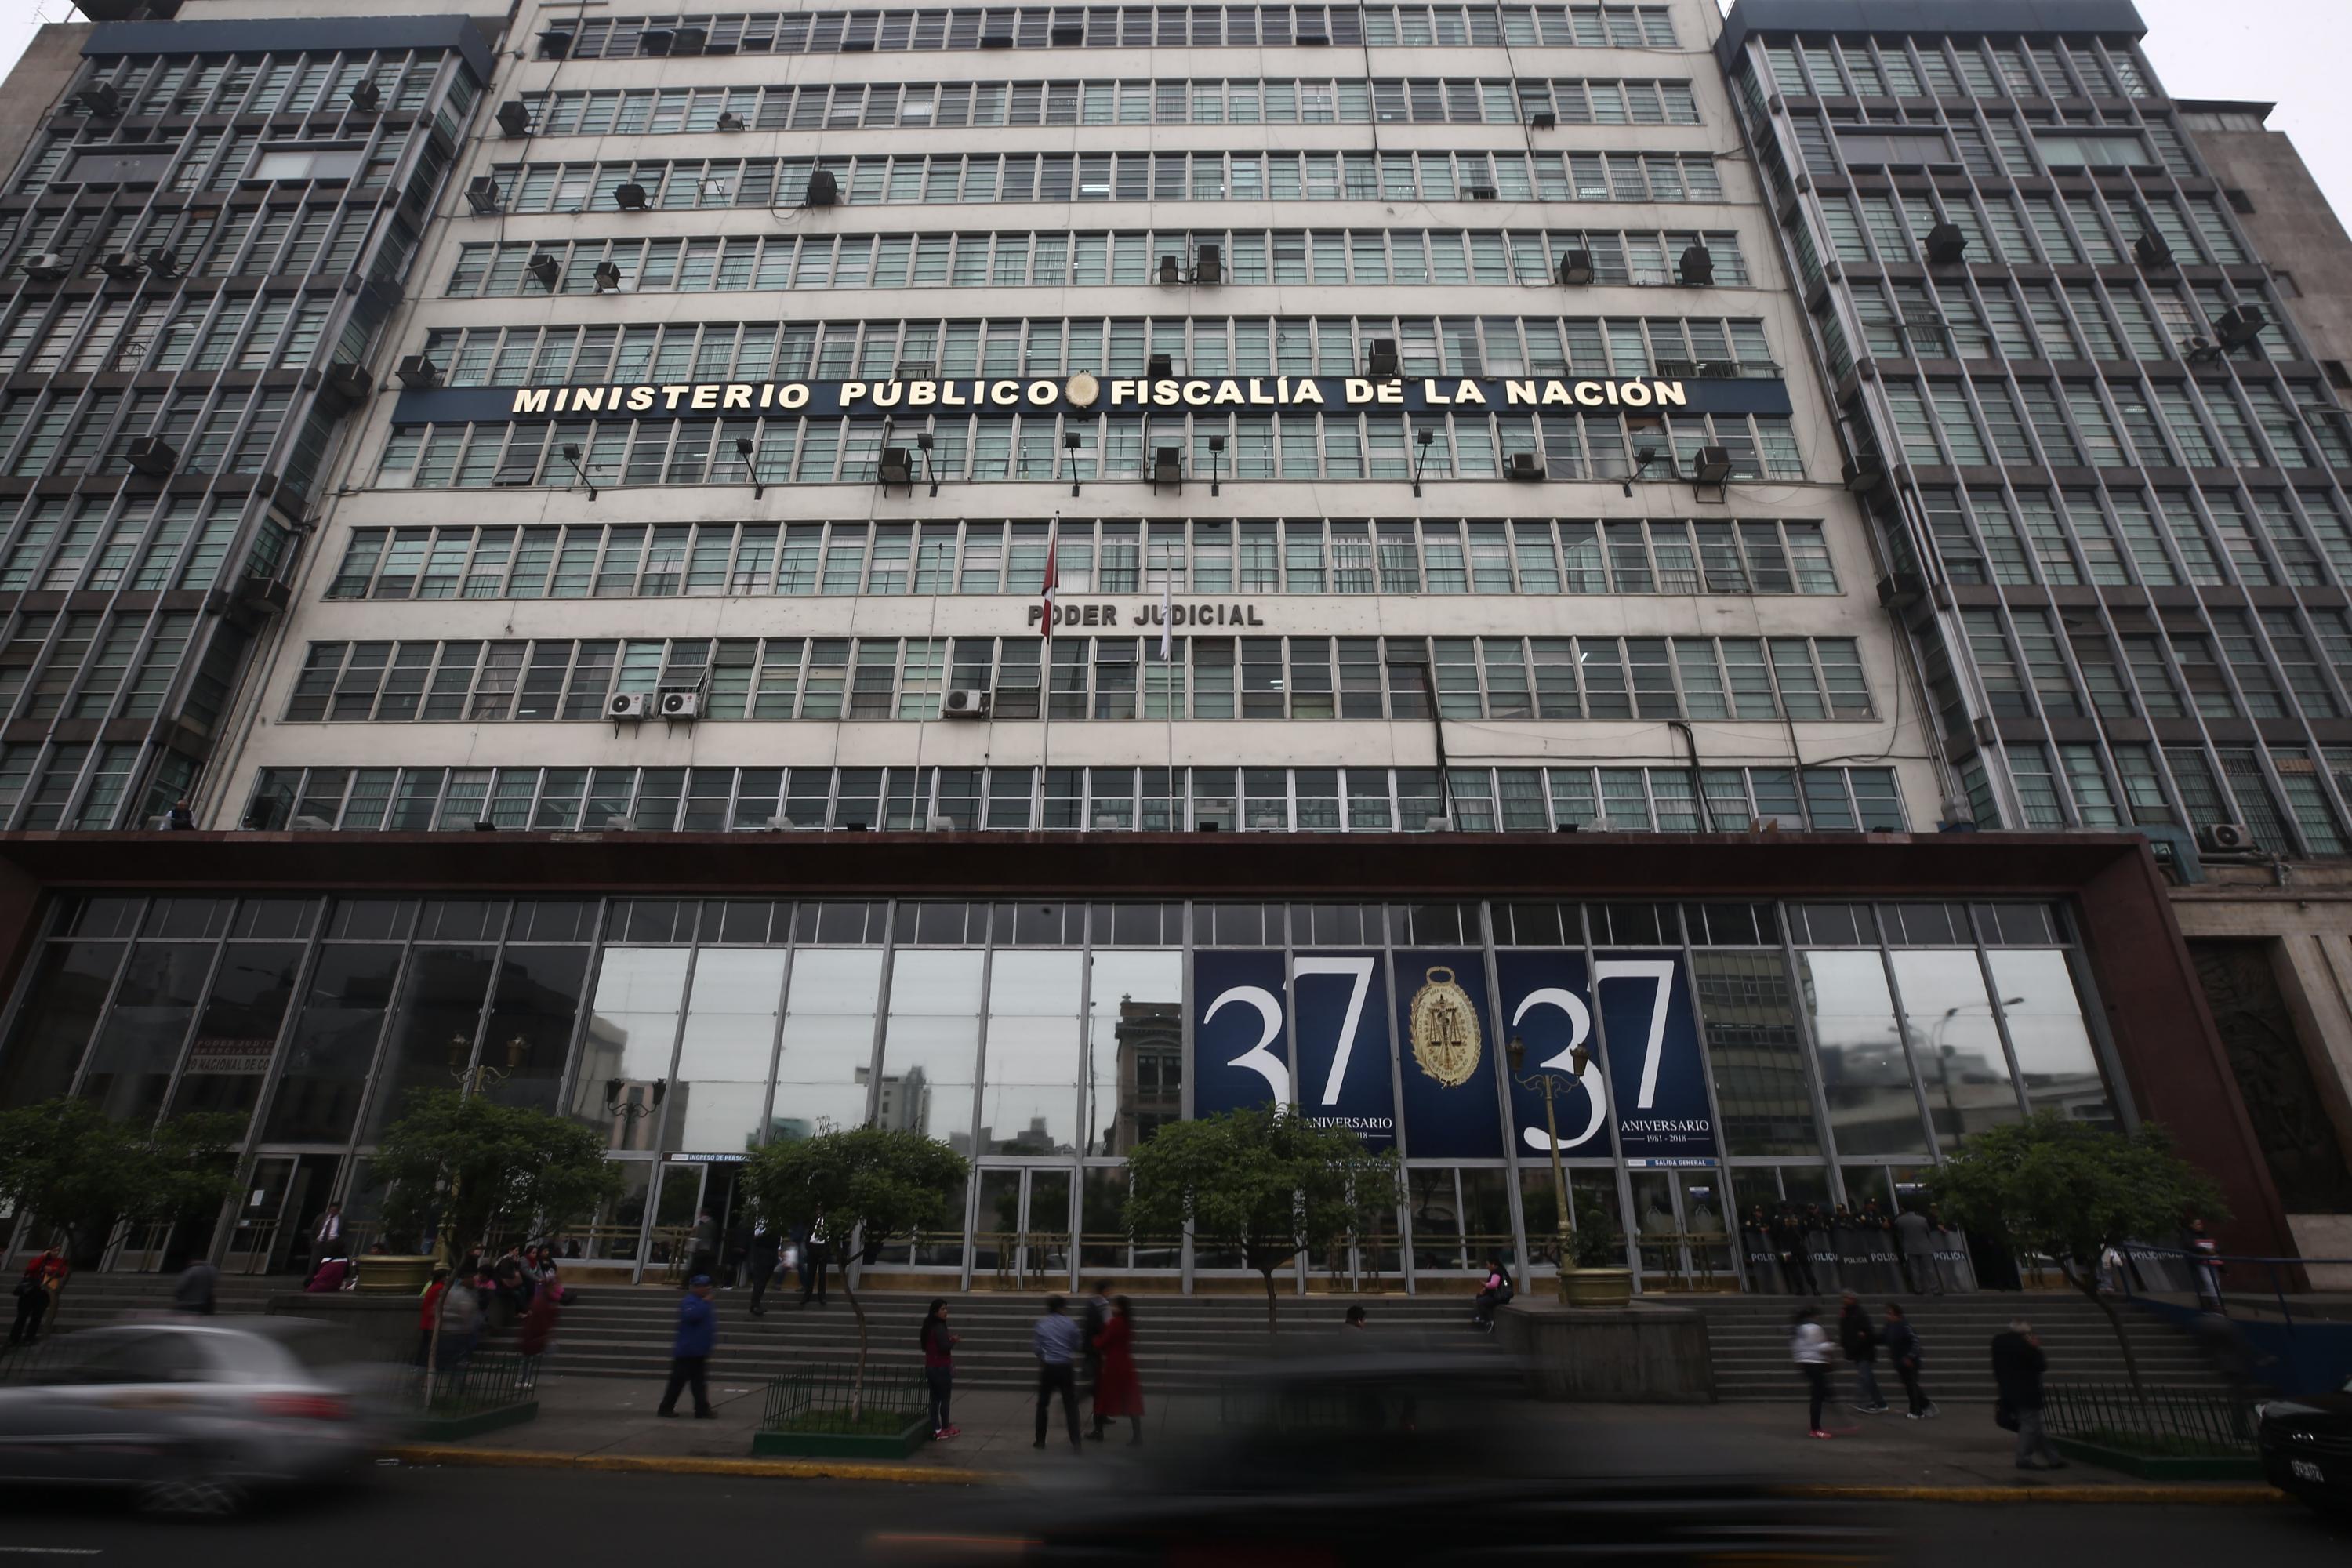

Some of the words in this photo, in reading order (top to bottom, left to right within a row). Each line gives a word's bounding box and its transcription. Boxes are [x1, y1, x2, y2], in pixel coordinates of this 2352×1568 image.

[512, 382, 810, 413] MINISTERIO
[839, 377, 1058, 407] PÚBLICO
[1110, 376, 1325, 405] FISCALÍA
[1346, 378, 1404, 404] DE
[1425, 379, 1486, 405] LA
[1507, 375, 1688, 406] NACIÓN
[1134, 604, 1264, 626] JUDICIAL
[200, 1058, 241, 1071] NACIONAL
[244, 1058, 257, 1071] DE
[1512, 960, 1675, 1150] 37
[1621, 1120, 1709, 1132] ANIVERSARIO
[1646, 1134, 1663, 1143] 1981
